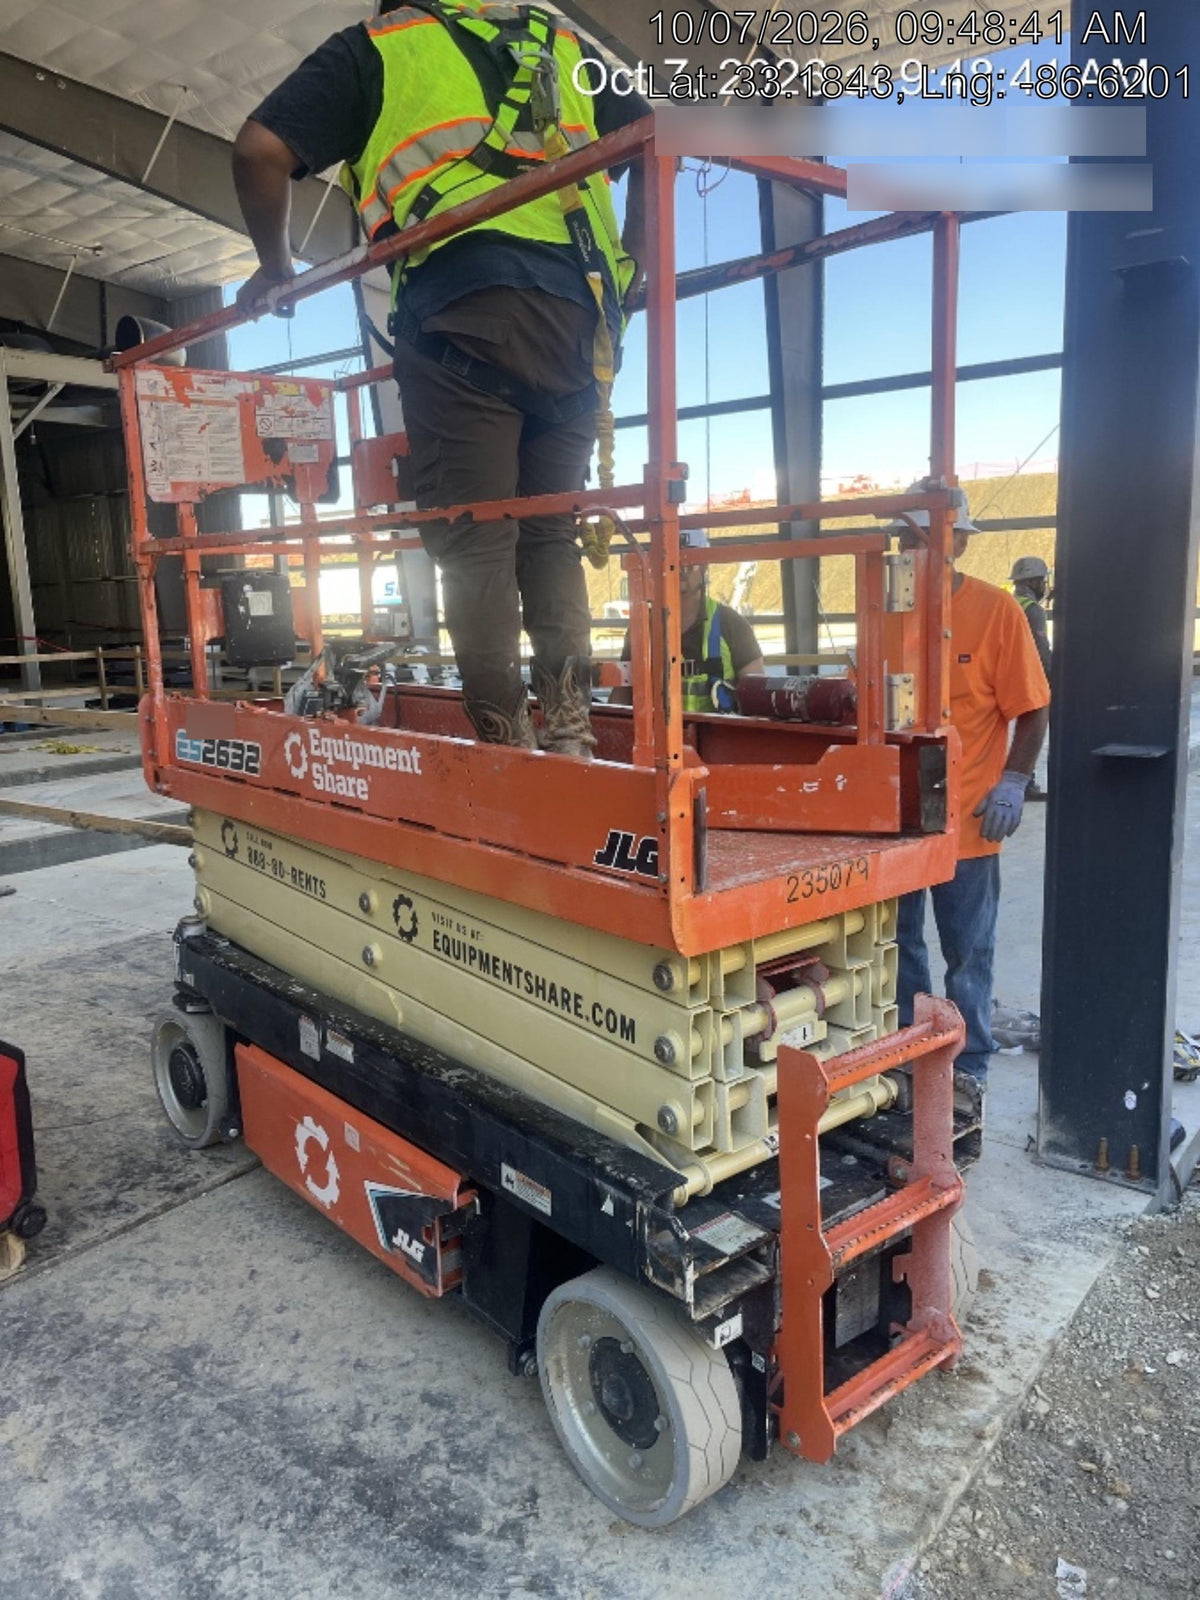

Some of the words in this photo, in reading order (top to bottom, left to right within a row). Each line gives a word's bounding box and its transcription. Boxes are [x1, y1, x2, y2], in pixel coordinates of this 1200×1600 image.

[176, 729, 261, 777] ES2632
[308, 728, 422, 775] Equipment
[312, 762, 369, 800] Share
[593, 828, 659, 878] JLG
[786, 856, 869, 904] 235079
[432, 928, 636, 1044] EQUIPMENTSHARE.COM
[392, 1228, 425, 1263] JLG
